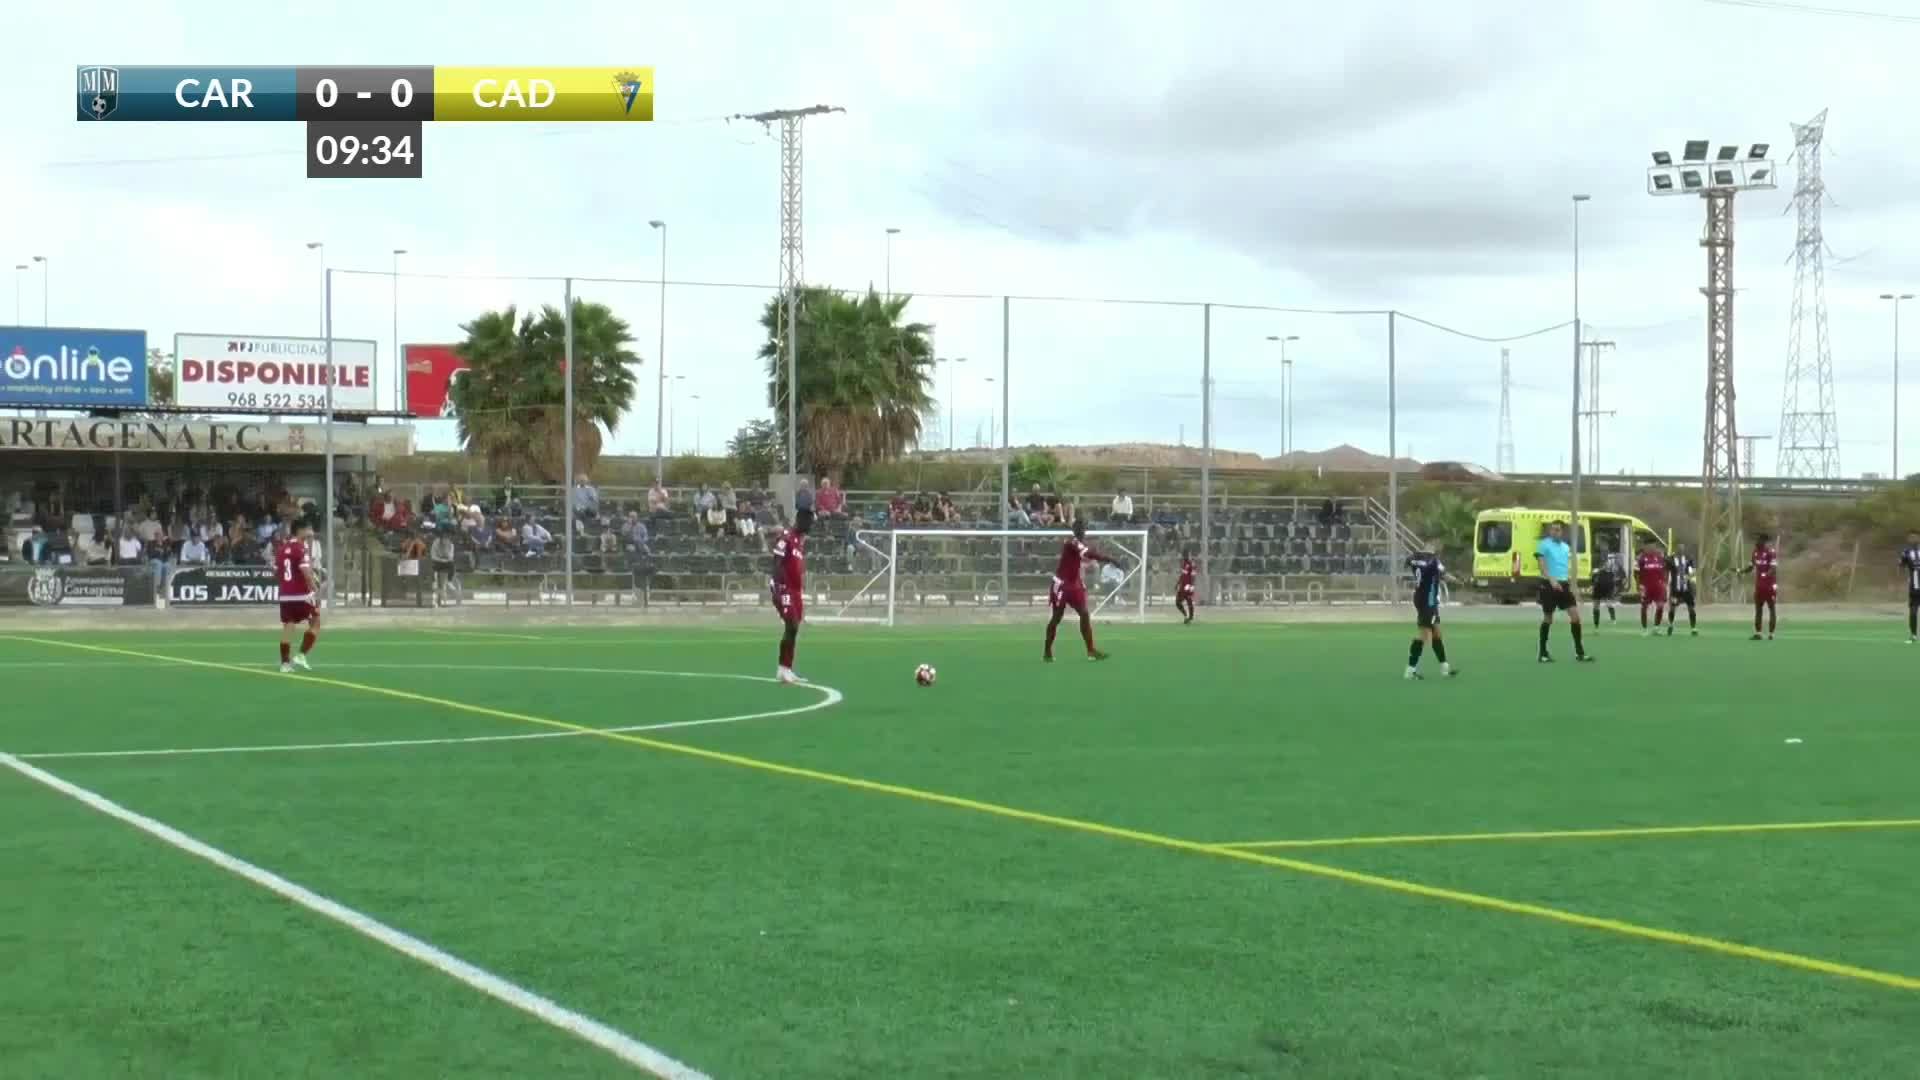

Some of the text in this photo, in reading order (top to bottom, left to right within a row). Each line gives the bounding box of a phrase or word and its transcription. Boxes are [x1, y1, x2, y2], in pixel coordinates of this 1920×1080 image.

[0, 345, 133, 382] online
[182, 359, 369, 388] DISPONIBLE
[227, 392, 325, 409] 968 522 534
[206, 424, 269, 451] F.C.
[283, 558, 292, 581] 3
[64, 585, 124, 597] Cartagena
[170, 585, 279, 601] LOS JAZMI
